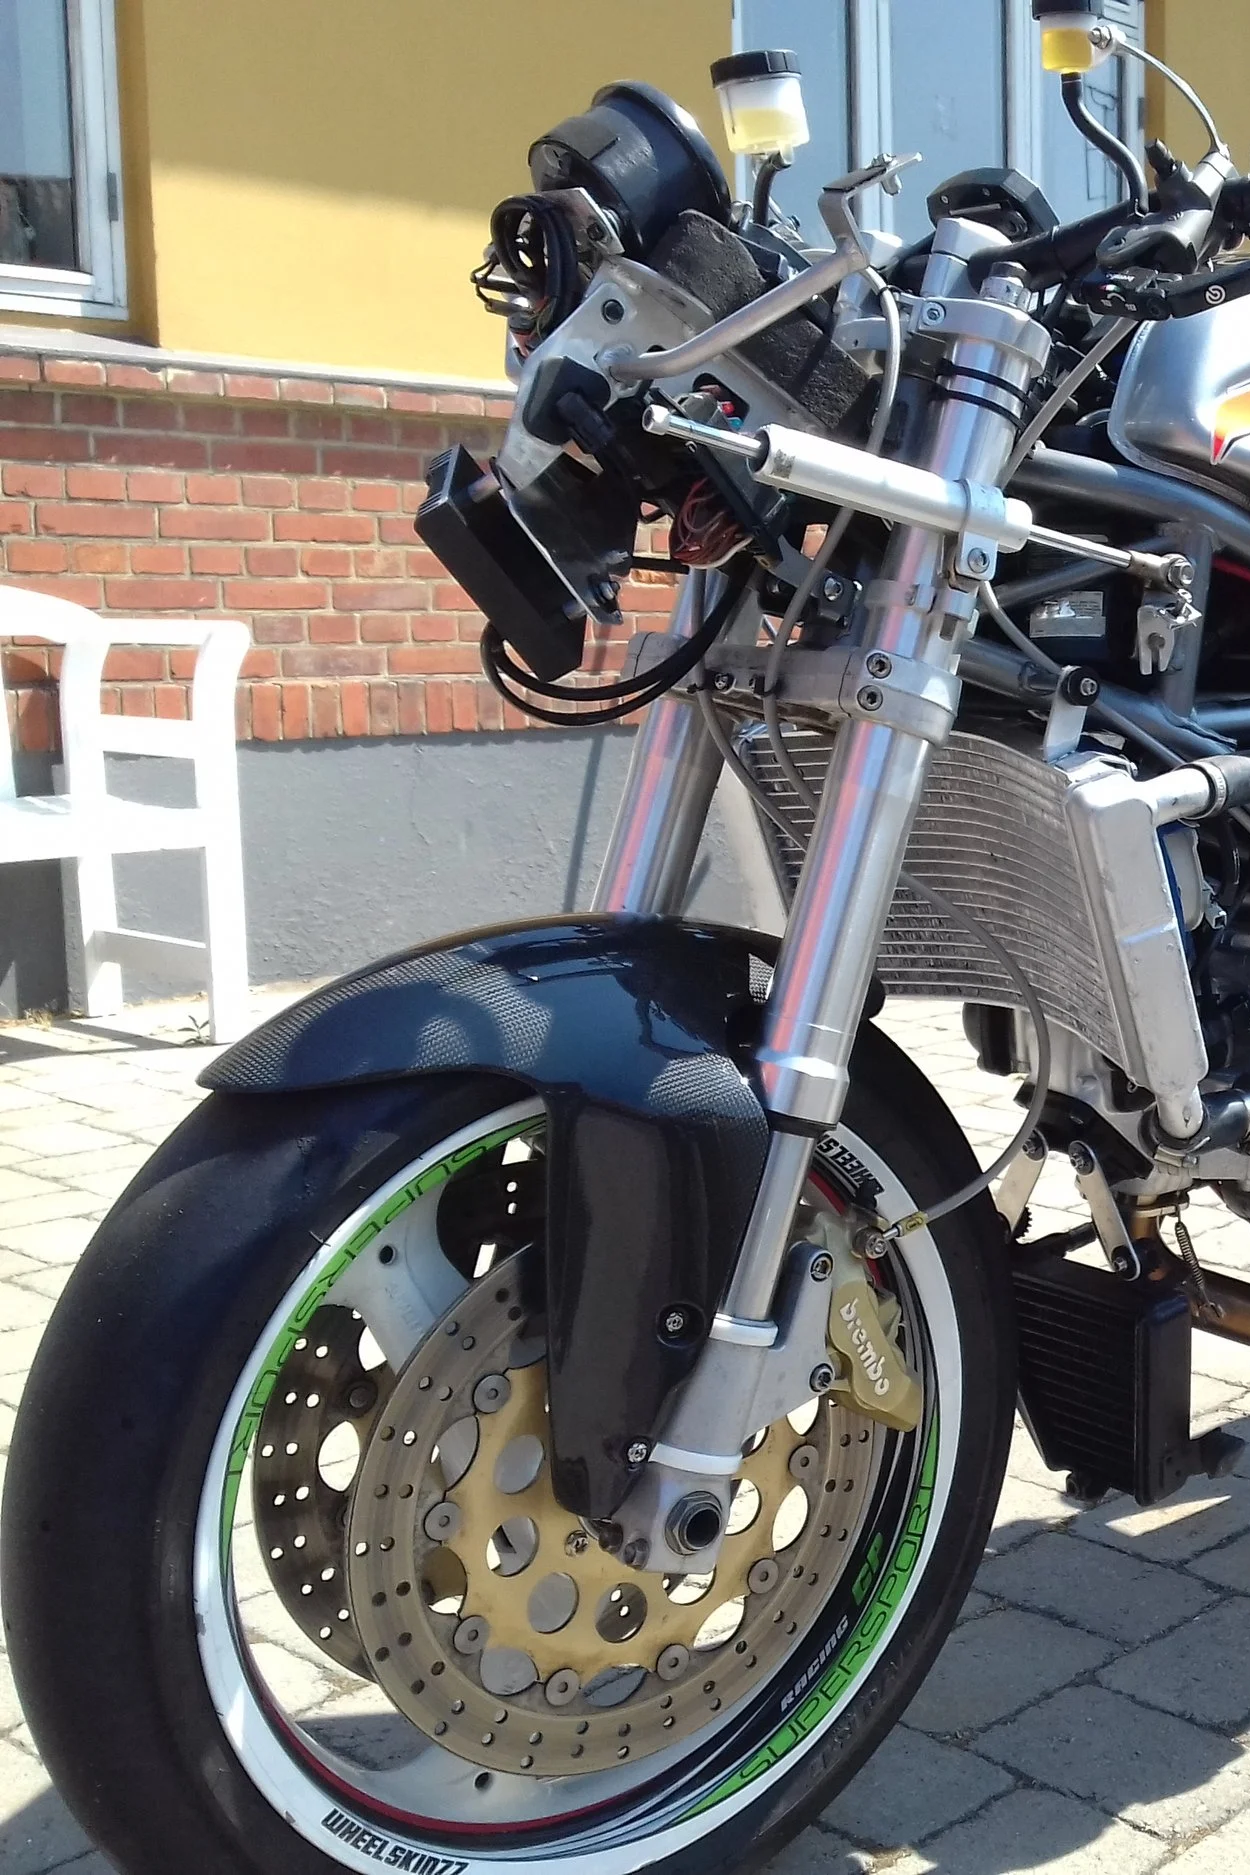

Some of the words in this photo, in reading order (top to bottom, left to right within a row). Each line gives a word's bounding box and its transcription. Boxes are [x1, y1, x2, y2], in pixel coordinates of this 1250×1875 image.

[840, 1297, 890, 1396] brembo
[739, 1472, 934, 1780] SUPERSPORT
[781, 1614, 849, 1713] RACING
[321, 1807, 470, 1875] WHEELSKINZZ
